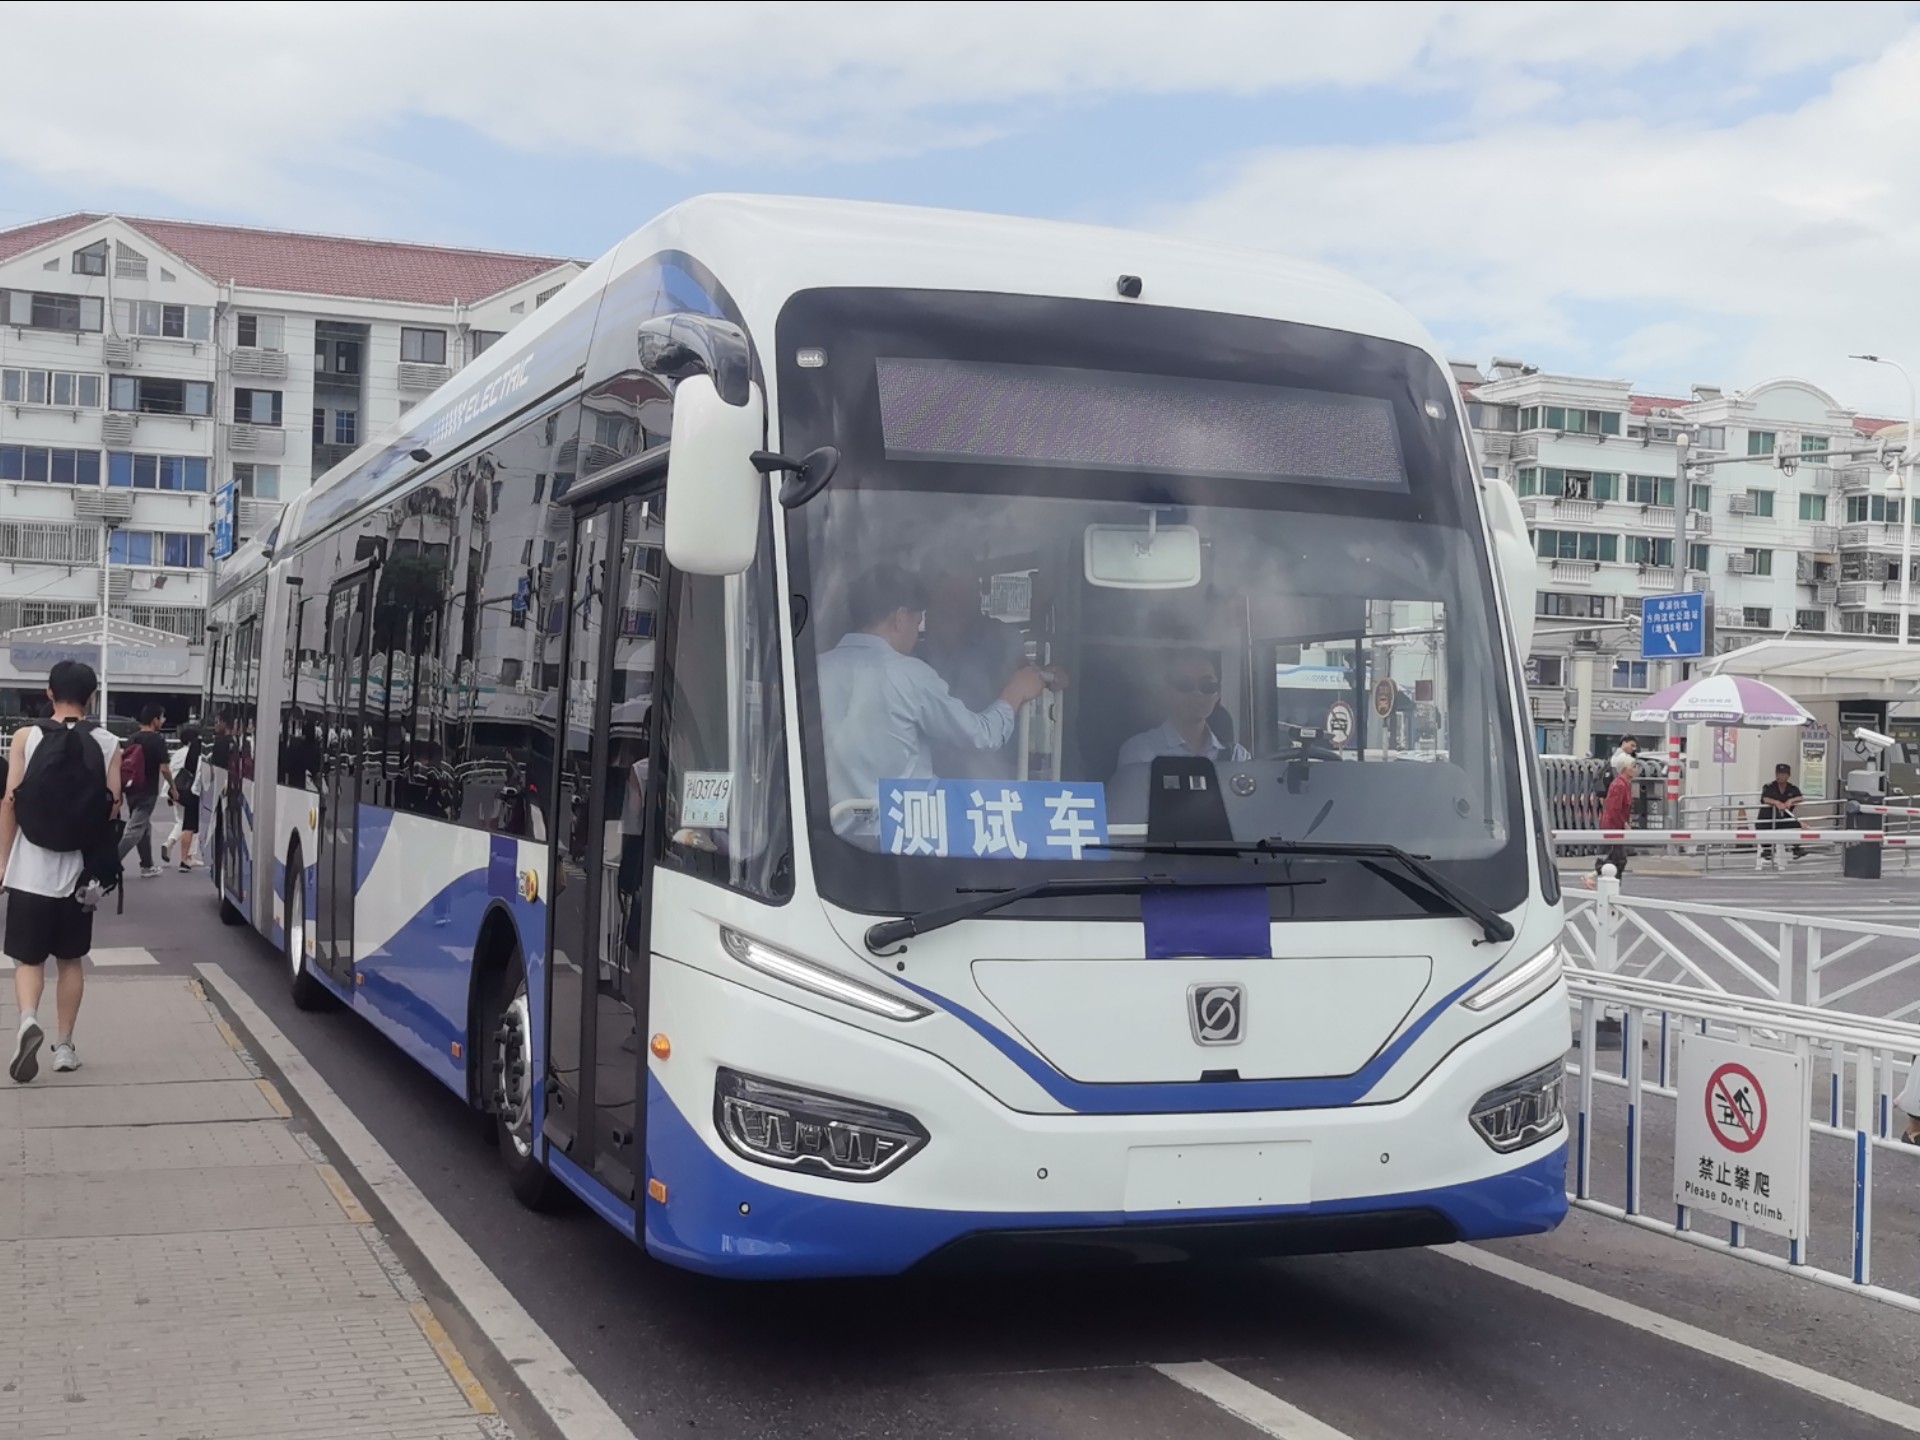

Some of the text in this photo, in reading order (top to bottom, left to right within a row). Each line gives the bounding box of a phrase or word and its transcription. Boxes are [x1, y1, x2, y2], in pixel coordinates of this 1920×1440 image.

[888, 789, 1101, 860] 测试车
[1685, 1181, 1716, 1200] Please
[1721, 1193, 1748, 1211] Don't
[1698, 1155, 1771, 1198] 禁止攀爬
